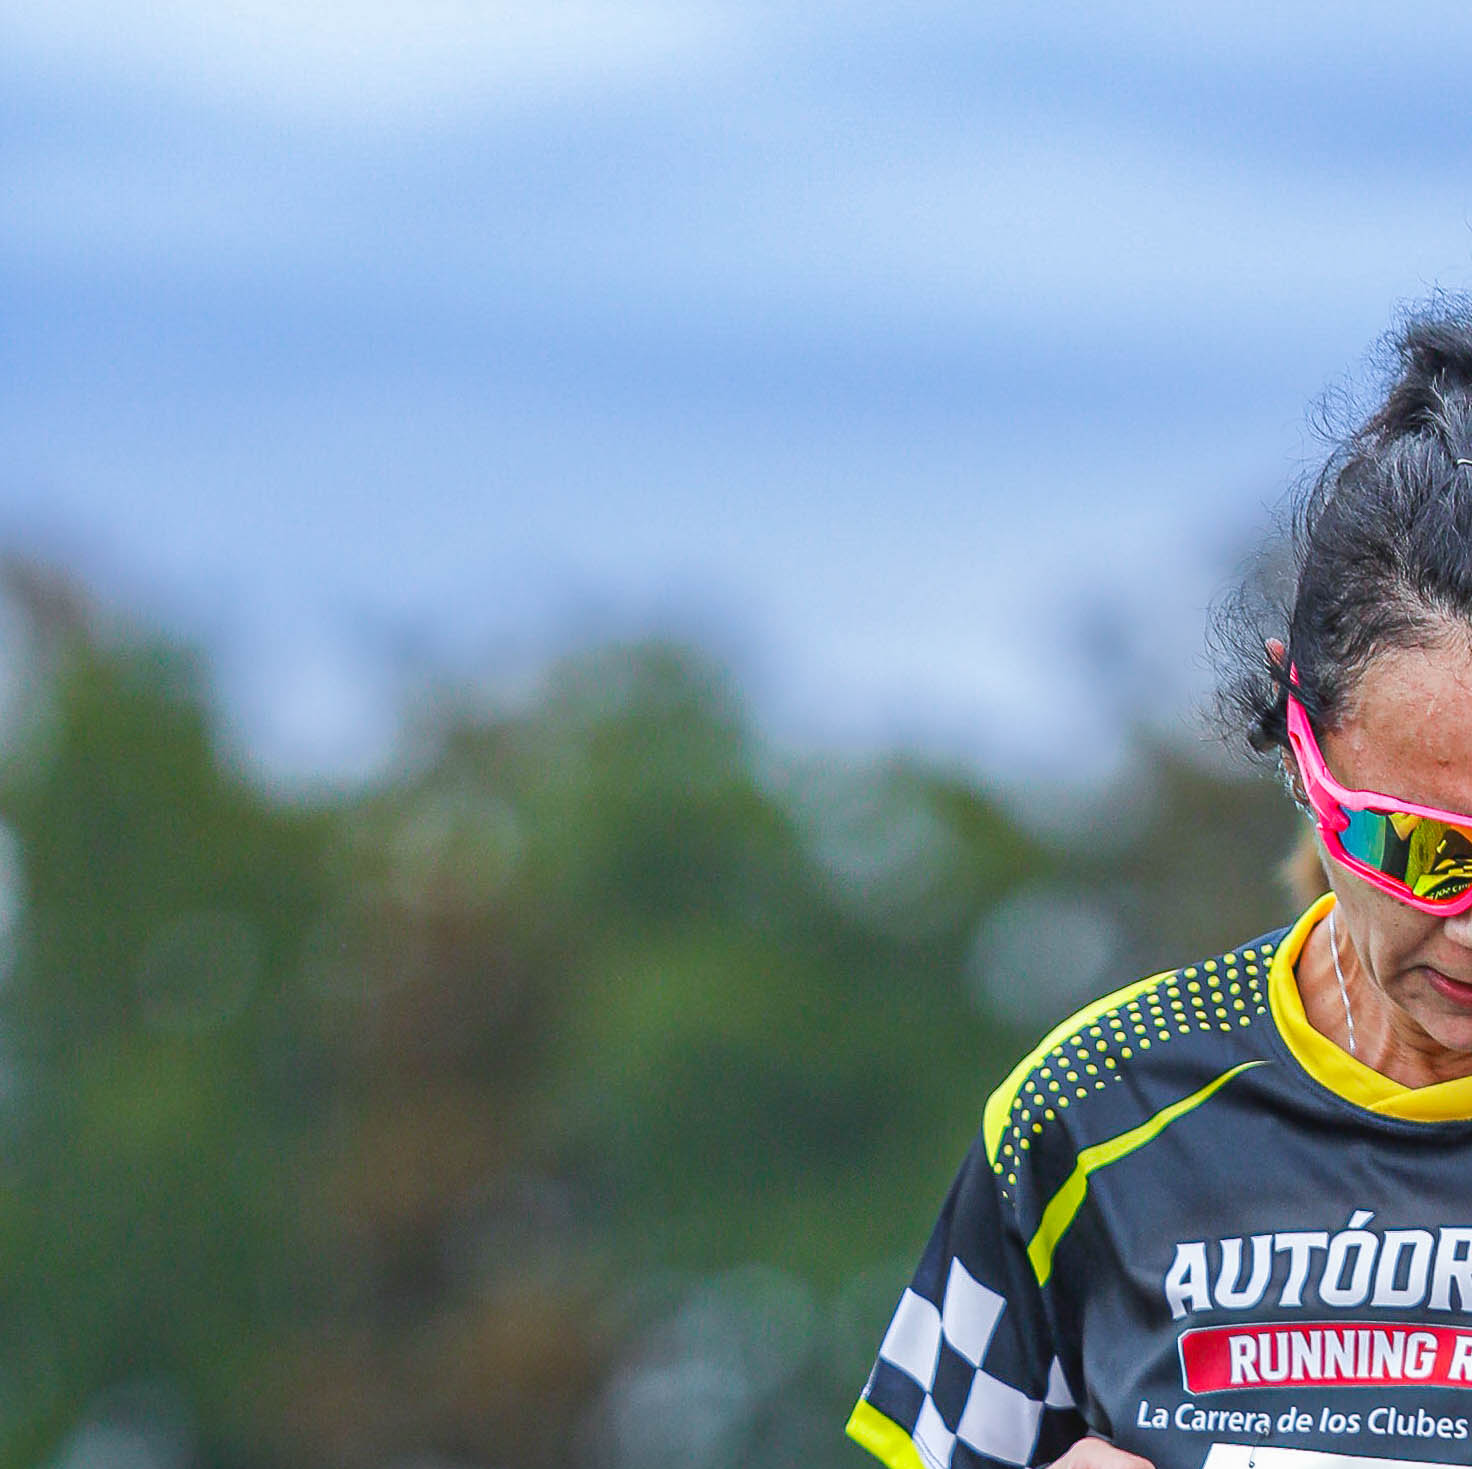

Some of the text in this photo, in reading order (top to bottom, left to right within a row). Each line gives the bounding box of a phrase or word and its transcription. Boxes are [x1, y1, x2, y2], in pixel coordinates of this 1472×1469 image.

[1227, 1329, 1439, 1386] RUNNING
[1136, 1400, 1169, 1429] La
[1174, 1402, 1272, 1434] Carrera
[1276, 1406, 1314, 1434] de
[1319, 1407, 1362, 1434] los
[1367, 1406, 1469, 1440] Clubes
